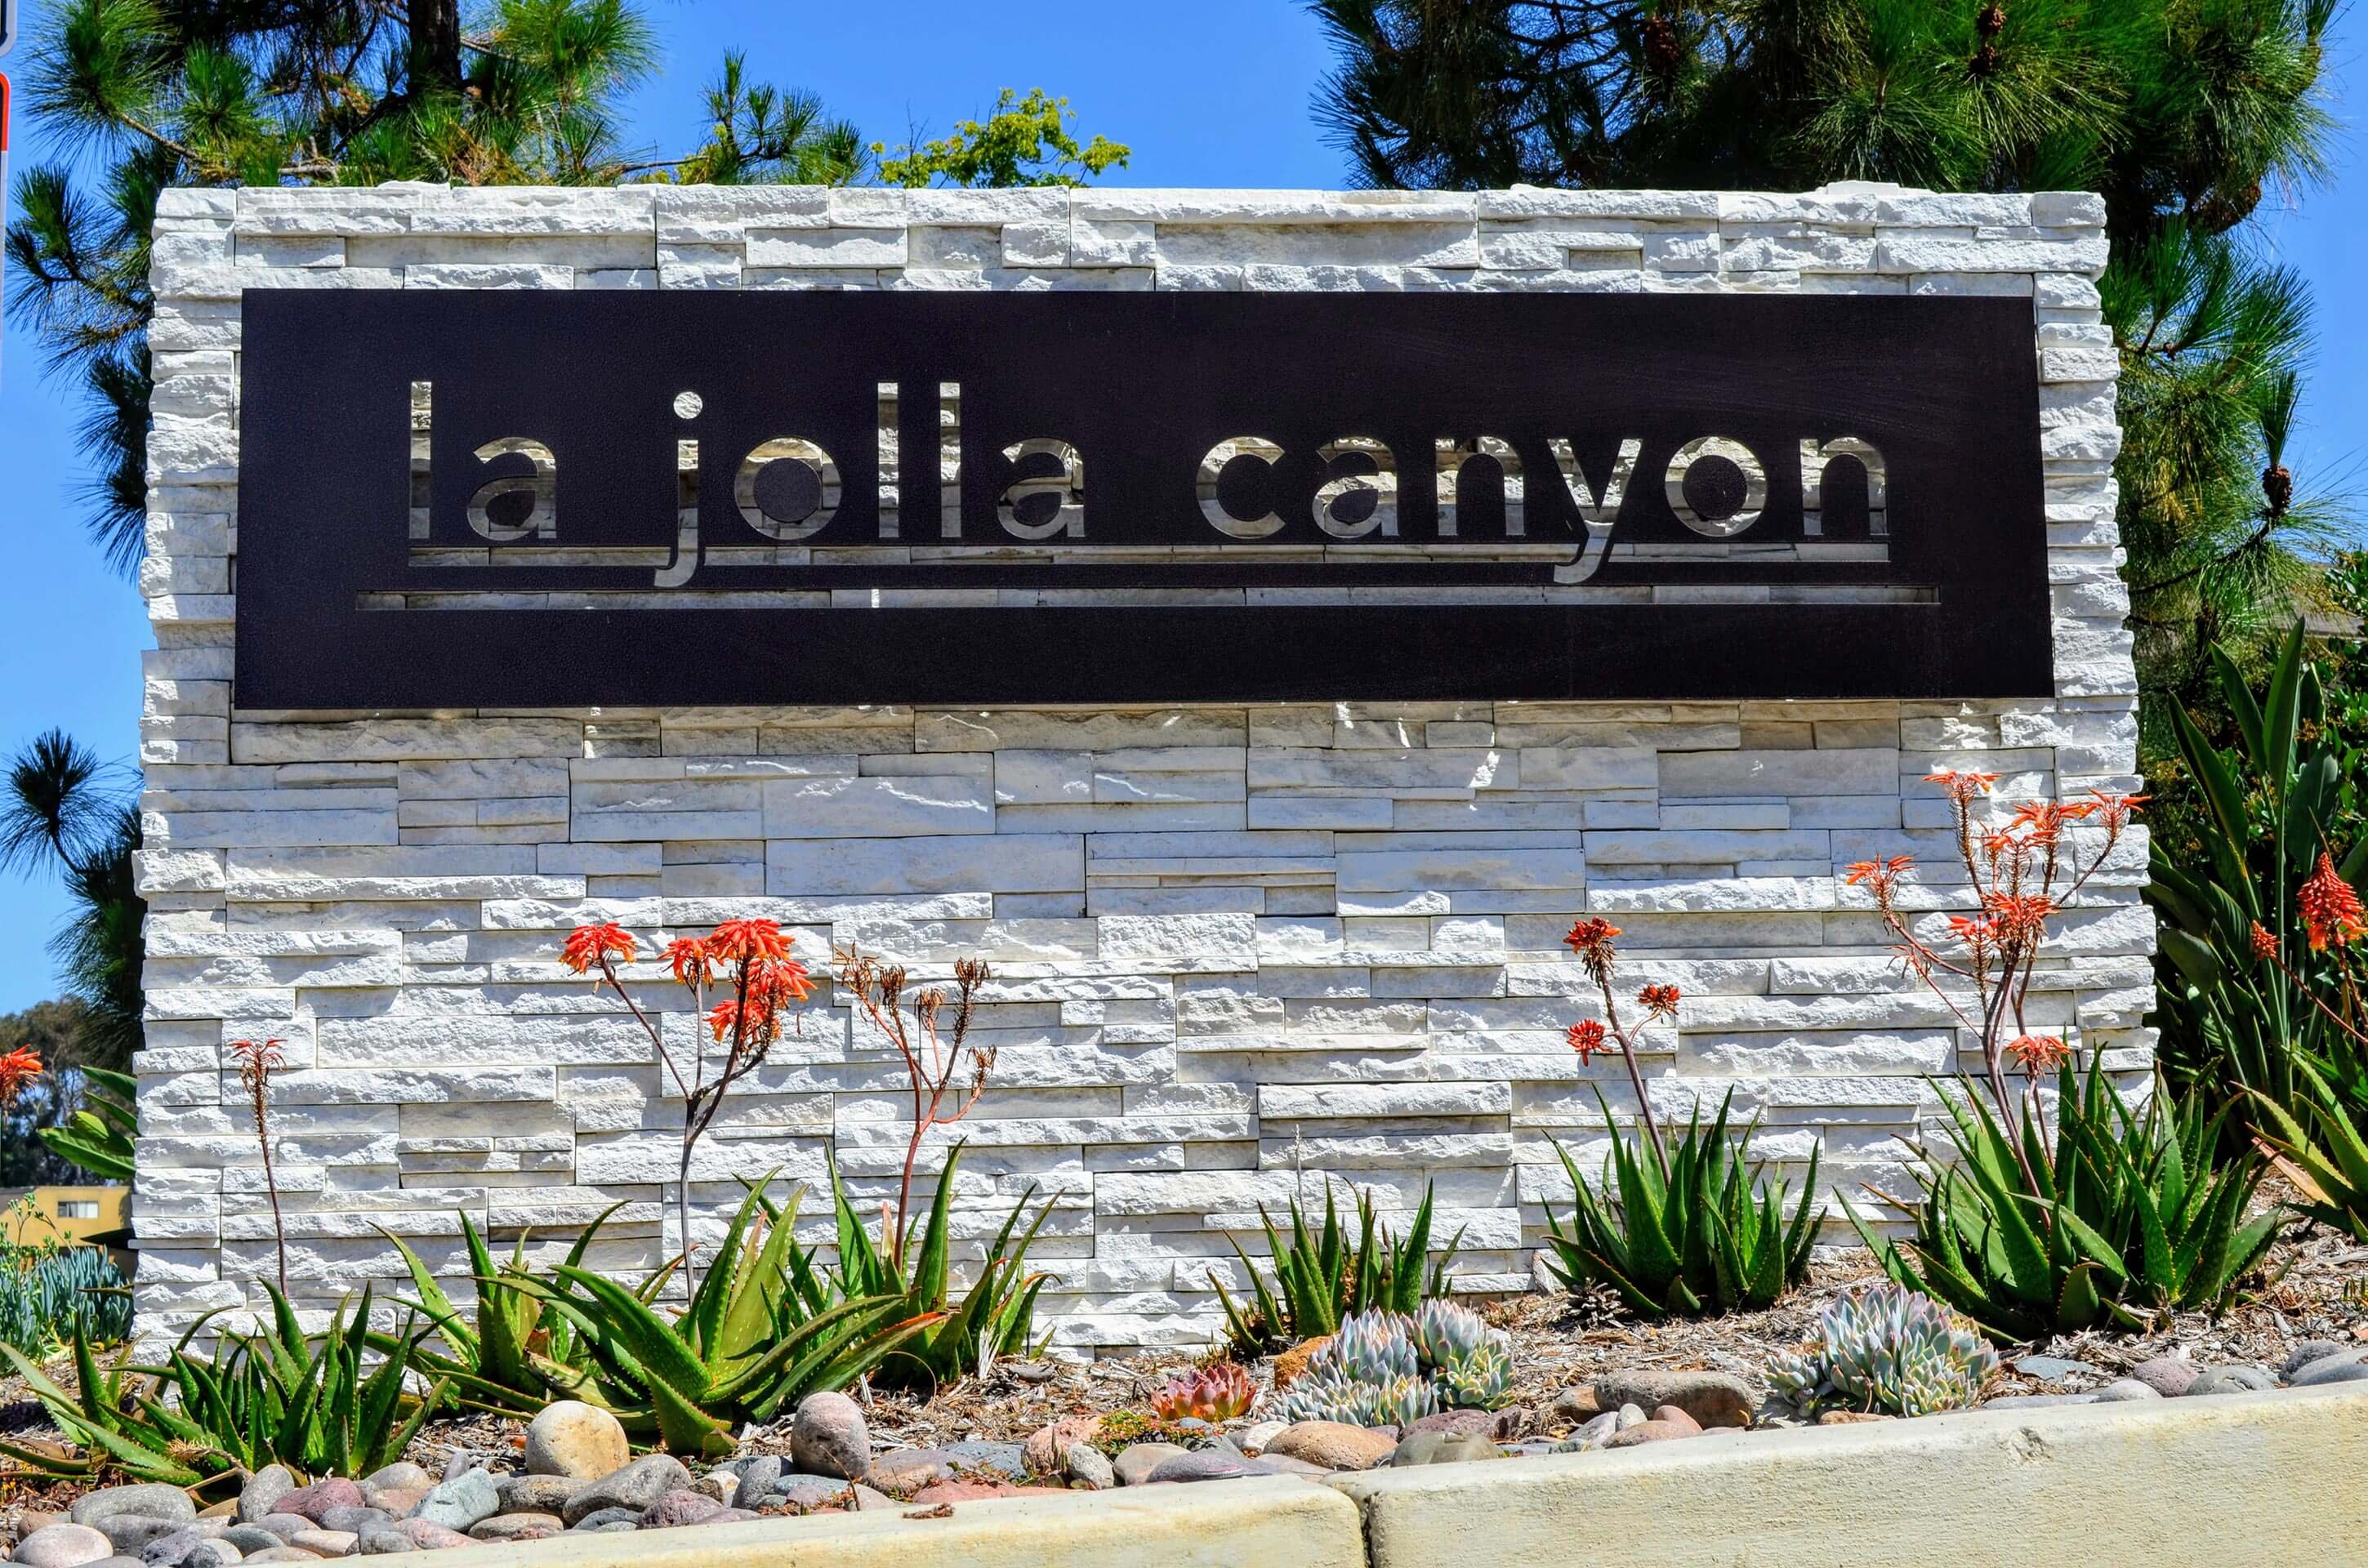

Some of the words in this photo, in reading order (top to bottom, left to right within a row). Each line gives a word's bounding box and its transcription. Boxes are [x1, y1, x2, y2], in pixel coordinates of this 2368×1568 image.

[408, 381, 558, 540] la
[653, 381, 1086, 588] jolla
[1195, 435, 1890, 585] canyon
